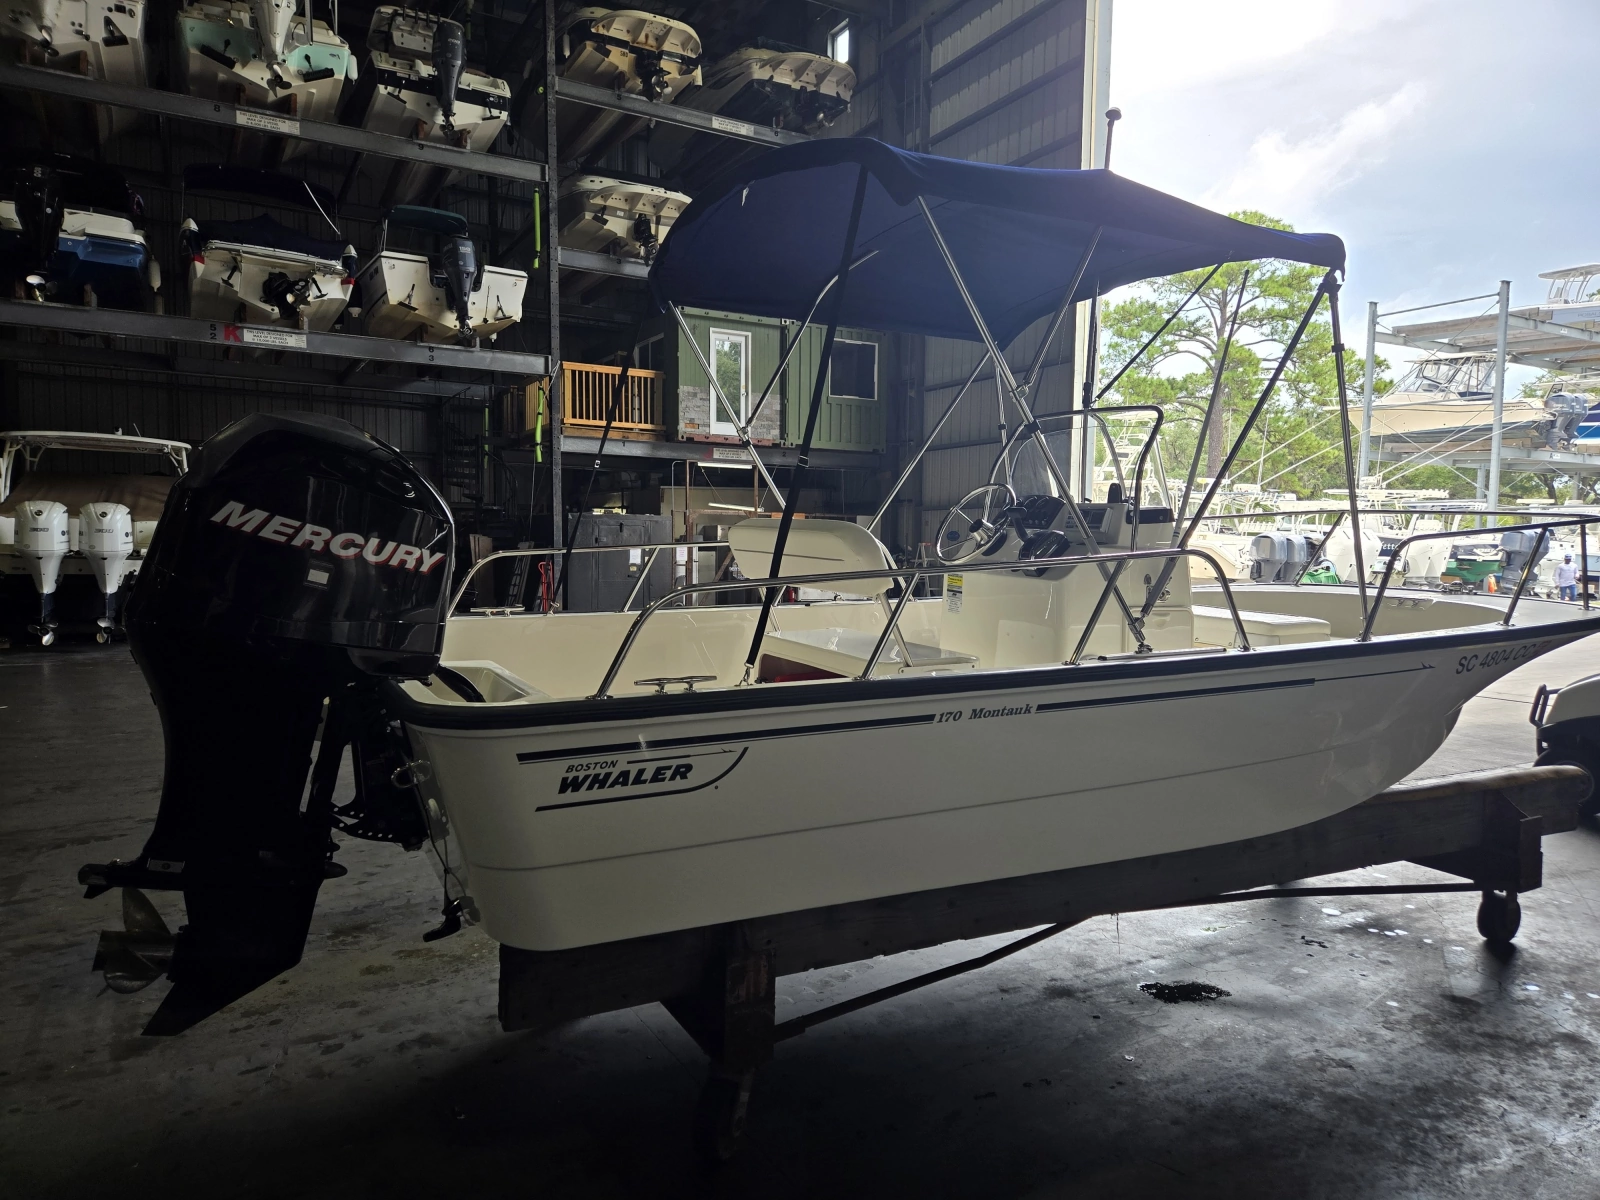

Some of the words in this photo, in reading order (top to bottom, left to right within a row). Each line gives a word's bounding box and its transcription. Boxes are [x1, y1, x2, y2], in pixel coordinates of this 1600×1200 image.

[213, 104, 220, 112] 8
[223, 325, 242, 344] K
[209, 500, 446, 573] MERCURY
[1456, 654, 1478, 675] SC
[1479, 648, 1515, 669] 4804
[1513, 643, 1536, 661] CC
[936, 710, 963, 723] 170
[968, 703, 1033, 720] Montauk
[565, 759, 618, 774] BOSTON
[558, 763, 694, 795] WHALER
